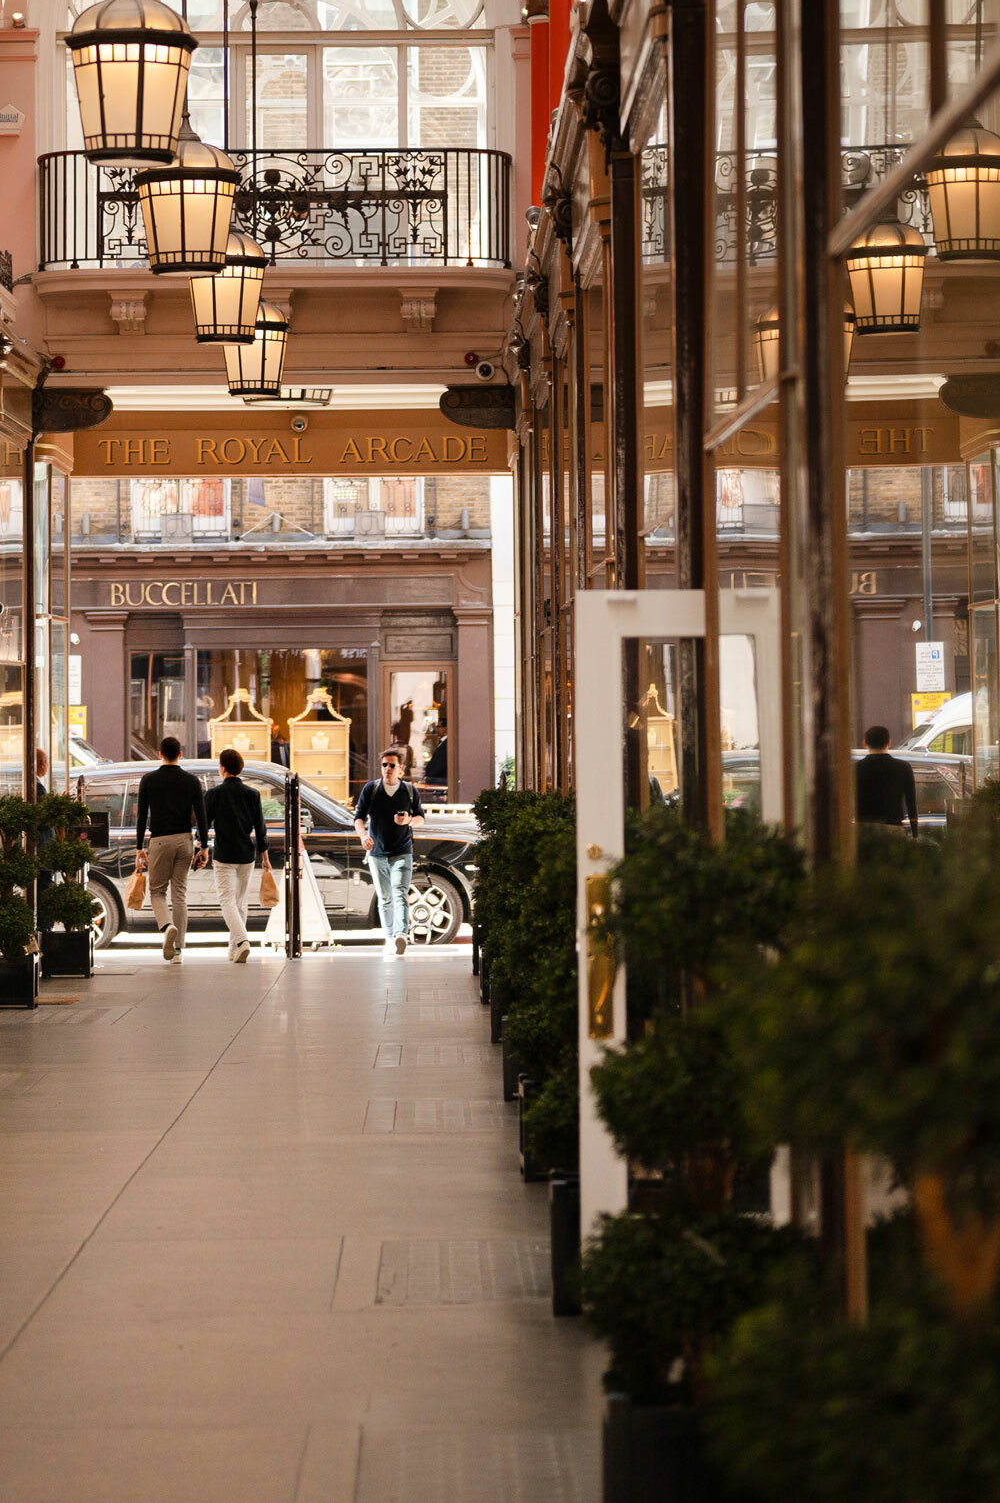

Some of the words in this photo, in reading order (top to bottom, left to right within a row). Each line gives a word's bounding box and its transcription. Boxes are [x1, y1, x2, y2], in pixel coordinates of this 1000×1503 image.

[98, 438, 172, 466] THE
[195, 437, 313, 465] ROYAL
[338, 436, 489, 464] ARCADE
[110, 581, 258, 607] BUCCELLATI
